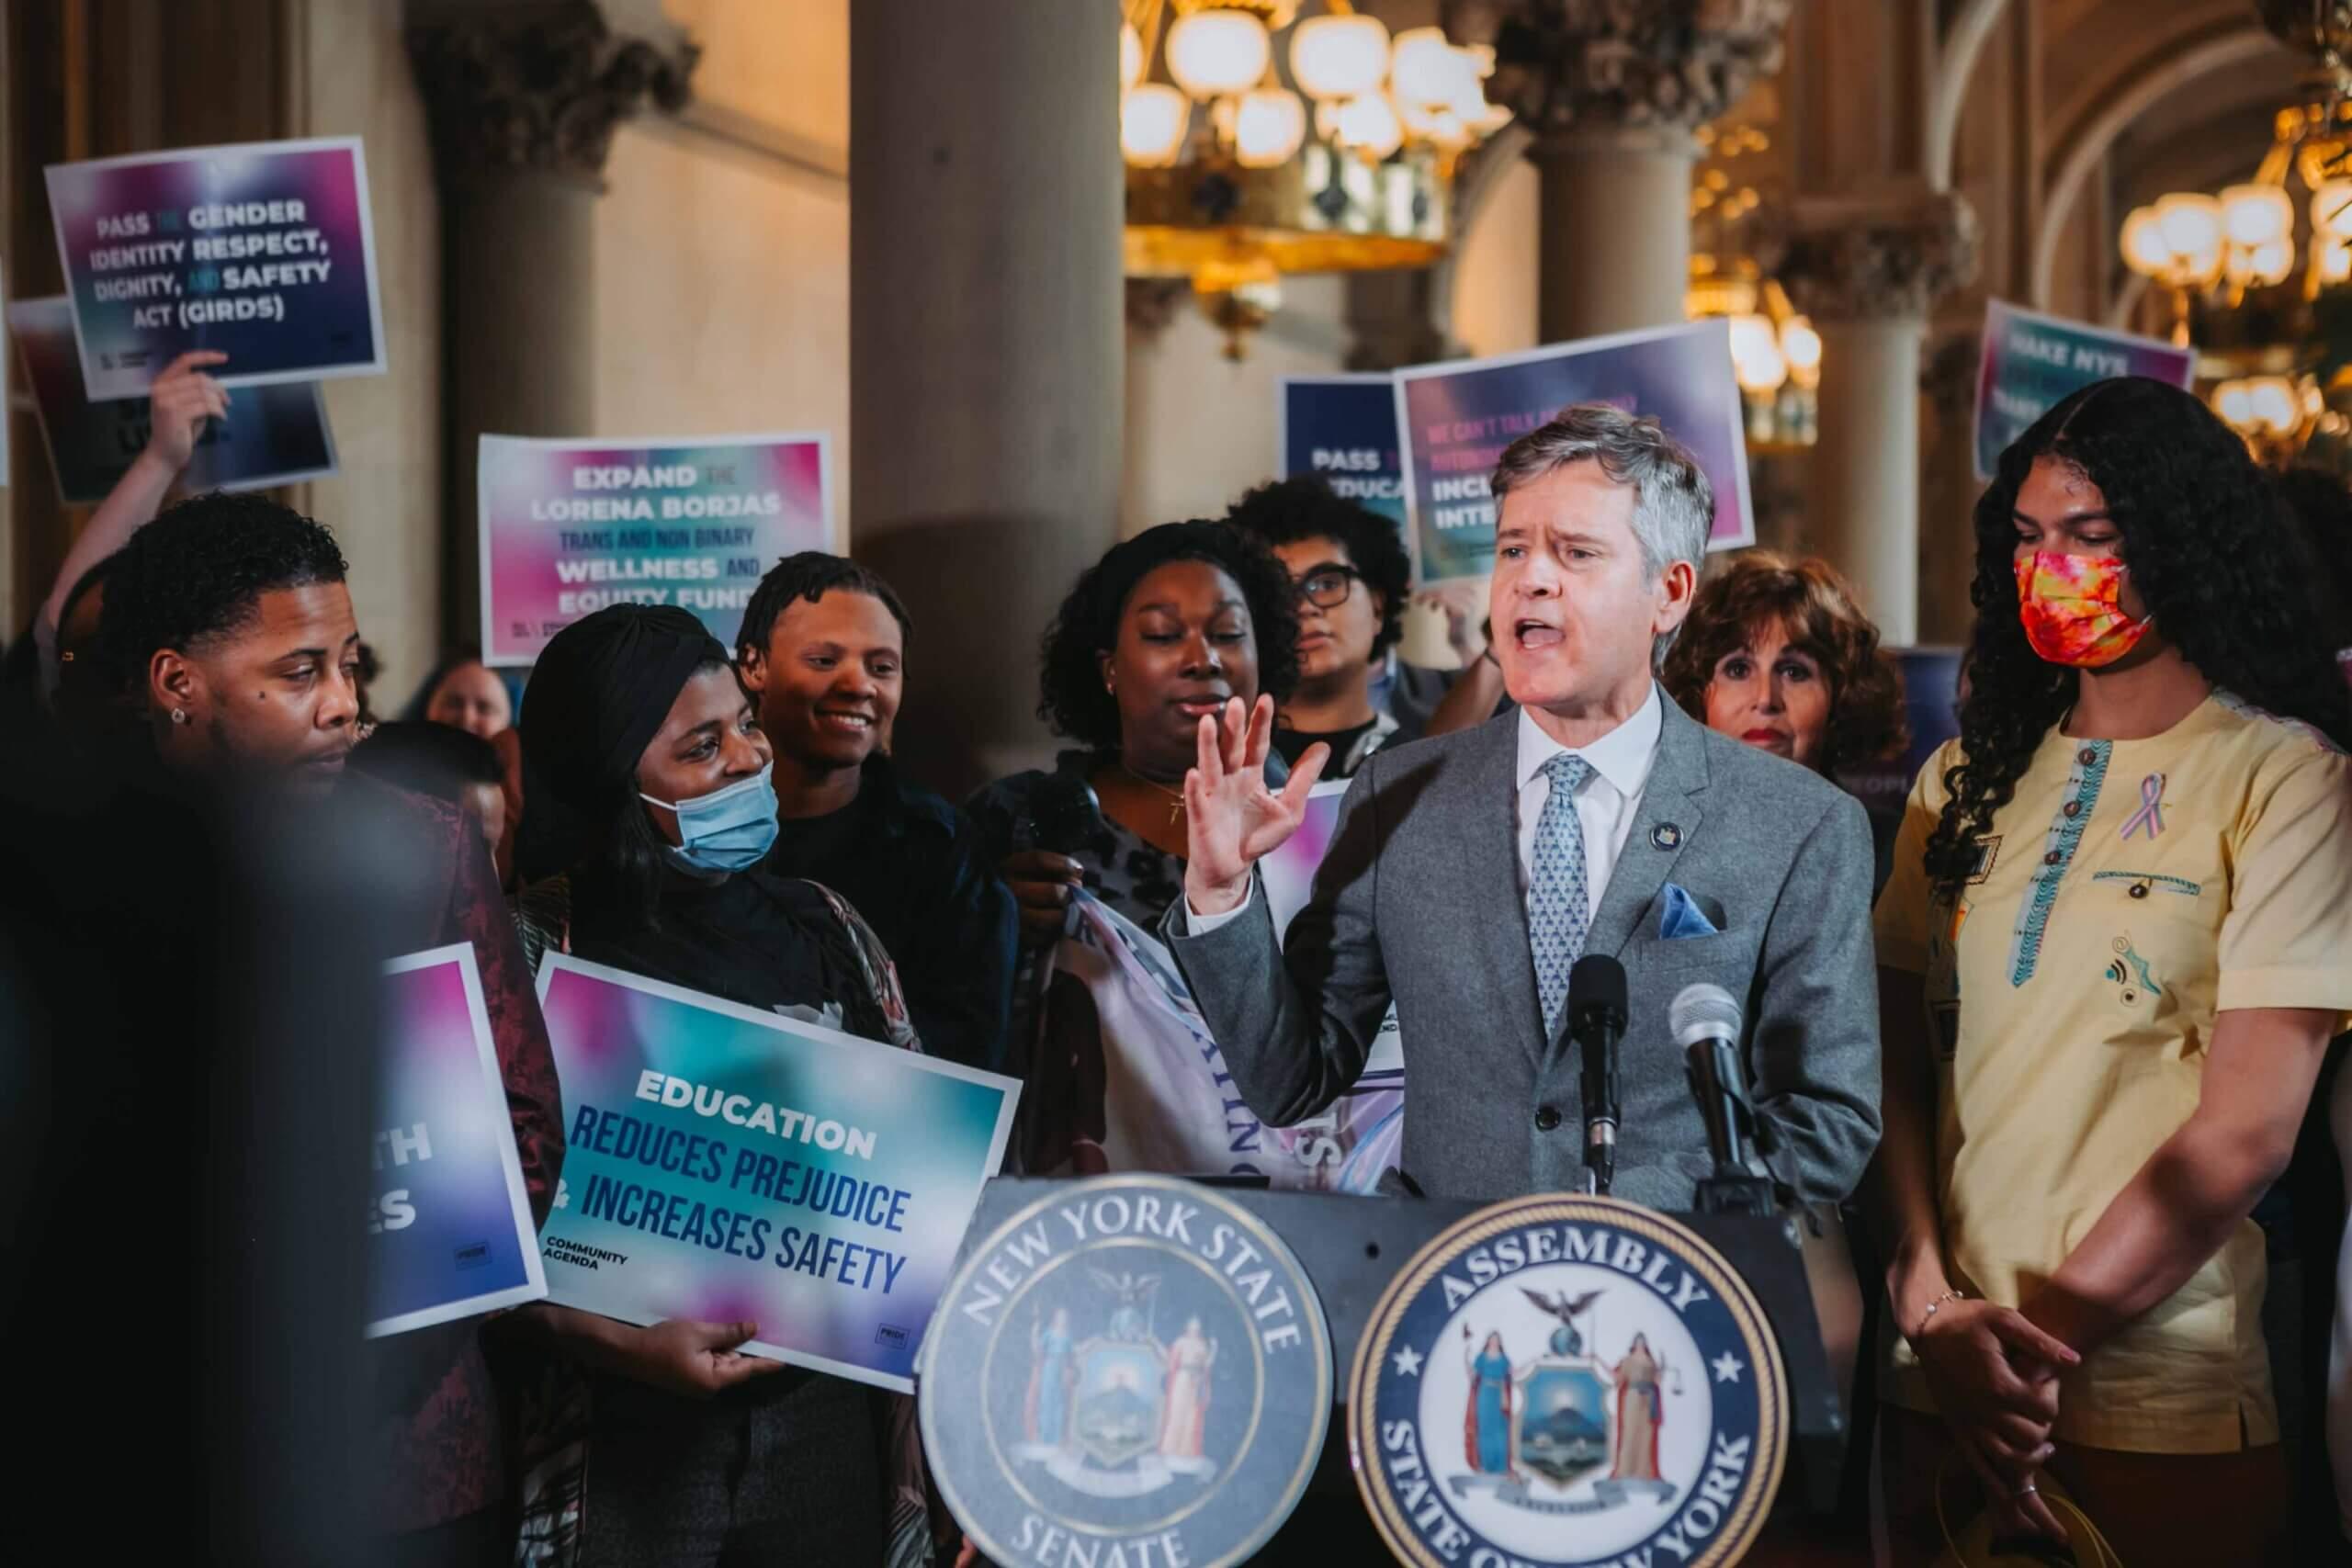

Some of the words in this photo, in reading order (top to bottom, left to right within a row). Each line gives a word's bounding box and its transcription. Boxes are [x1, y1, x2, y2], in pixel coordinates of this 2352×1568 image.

[96, 212, 150, 239] PASS
[188, 200, 305, 230] GENDER
[90, 241, 186, 271] IDENTITY
[193, 229, 328, 261] RESPECT,
[94, 273, 182, 302] DIGNITY,
[222, 260, 332, 290] SAFETY
[134, 305, 173, 329] ACT
[178, 293, 284, 329] (GIRDS)
[573, 464, 698, 490] EXPAND
[1311, 448, 1381, 471] PASS
[531, 496, 654, 522] LORENA
[662, 492, 781, 520] BORJAS
[560, 530, 614, 550] TRANS
[618, 529, 652, 549] AND
[656, 528, 691, 549] NON
[695, 527, 754, 548] BINARY
[556, 557, 718, 583] WELLNESS
[727, 558, 761, 577] AND
[636, 1069, 877, 1161] EDUCATION
[570, 1105, 728, 1183] REDUCES
[729, 1147, 912, 1233] PREJUDICE
[547, 1235, 628, 1265] COMMUNITY
[581, 1174, 772, 1261] INCREASES
[775, 1226, 907, 1295] SAFETY
[544, 1247, 599, 1270] AGENDA
[963, 1220, 1050, 1325] NEW
[1061, 1195, 1200, 1247] YORK
[1202, 1224, 1302, 1355] STATE
[1441, 1226, 1711, 1313] ASSEMBLY
[1383, 1419, 1470, 1561] STATE
[1655, 1431, 1751, 1561] YORK
[1012, 1514, 1191, 1568] SENATE
